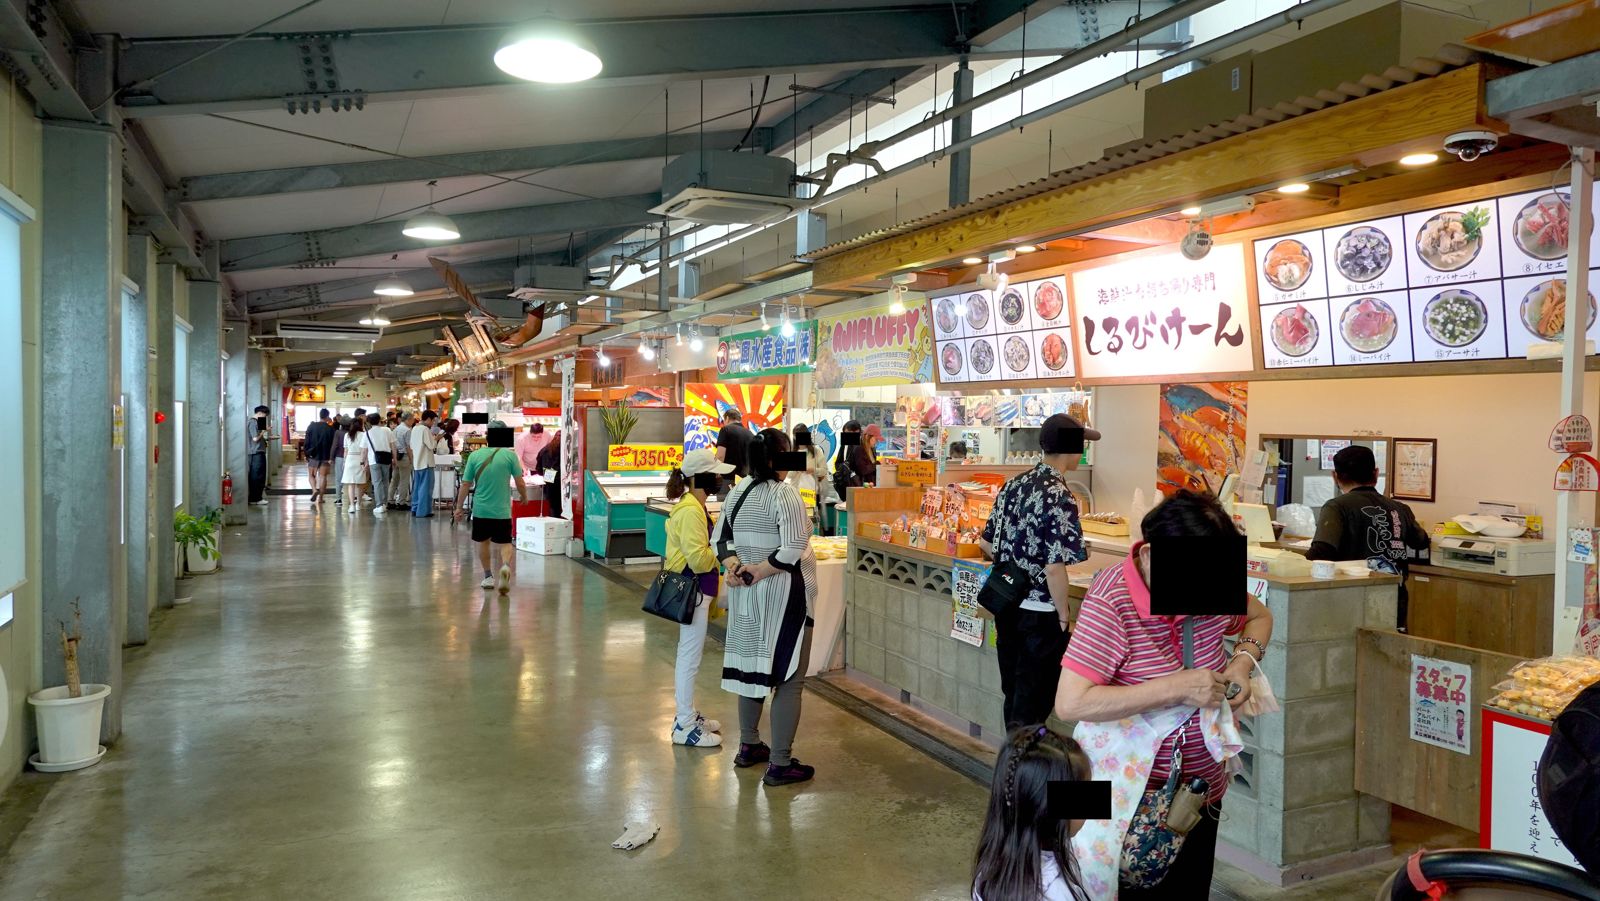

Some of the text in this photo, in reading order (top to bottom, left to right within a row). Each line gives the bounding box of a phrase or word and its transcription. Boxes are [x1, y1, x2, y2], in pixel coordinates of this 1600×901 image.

[1083, 301, 1244, 356] しるびけーん
[1416, 665, 1467, 691] スタッフ
[1416, 681, 1466, 706] 募集中
[1528, 760, 1542, 855] 100年を迎え
